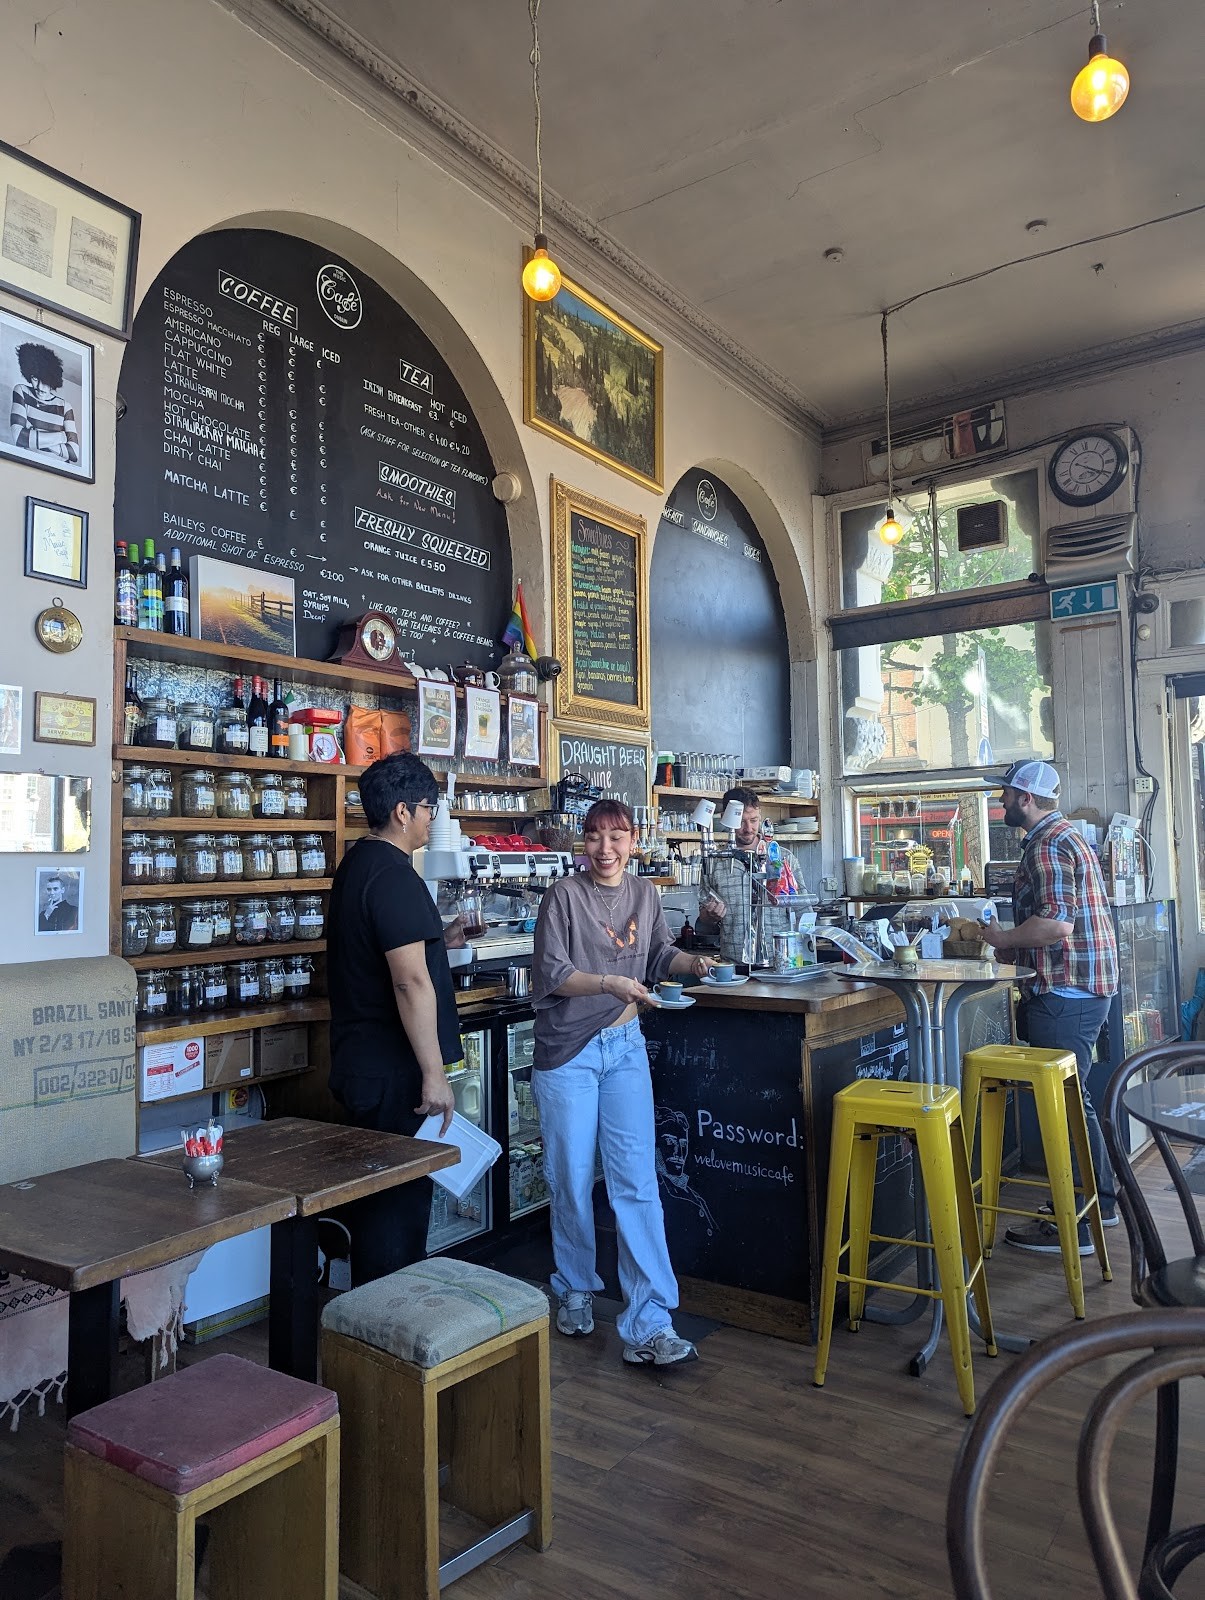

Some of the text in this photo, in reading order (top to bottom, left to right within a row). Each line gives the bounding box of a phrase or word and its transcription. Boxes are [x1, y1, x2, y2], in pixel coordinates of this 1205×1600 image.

[164, 288, 212, 318] ESPRESSO
[221, 277, 295, 324] COFFEE
[164, 302, 204, 326] ESPRESSO
[208, 320, 252, 346] MACCHIATO
[164, 316, 221, 348] AMERICANO
[165, 330, 232, 366] CAPPUCCINO
[262, 320, 341, 364] REG LARGE ICED
[164, 344, 190, 362] FLAT
[196, 358, 226, 379] WHITE
[164, 357, 198, 380] LATTE
[402, 364, 430, 390] TEA
[164, 371, 218, 402] STRAWBERRY
[220, 394, 245, 412] MOCHA
[164, 387, 204, 410] MOCHA
[363, 379, 383, 396] IRISH
[388, 390, 422, 413] BREAKFAST
[164, 403, 186, 417] HOT
[190, 411, 250, 440] CHOCOLATE
[430, 399, 467, 424] HOT ICED
[164, 412, 224, 444] STRAWBERRY
[226, 434, 258, 457] MATCHA
[164, 428, 192, 446] CHAI
[198, 440, 230, 460] LATTE
[364, 404, 386, 420] FRESH
[429, 434, 448, 447] €4.00
[449, 442, 470, 456] €4.20
[164, 442, 193, 461] DIRTY
[198, 455, 222, 471] CHAI
[360, 425, 488, 486] (ASK STAFF FOR SELECTION OF TEA FLAVOURS)
[164, 469, 208, 494] MATCHA
[214, 486, 250, 506] LATTE
[376, 488, 394, 502] Ask
[400, 495, 410, 506] for
[414, 500, 426, 513] New
[380, 466, 453, 506] SMOOTHIES
[164, 512, 206, 532] BAILEYS
[211, 526, 246, 544] COFFEE
[357, 511, 487, 567] FRESHLY SQUEEZED
[693, 521, 728, 547] SANDWICHES
[744, 545, 760, 561] SIDES
[164, 528, 305, 572] ADDITIONAL SHOT OF ESPRESSO
[364, 541, 391, 556] ORANGE
[395, 550, 418, 565] JUICE
[303, 590, 318, 600] OAT,
[332, 596, 350, 609] MILK,
[361, 568, 472, 605] ASK FOR OTHER BAILEYS DRINKS
[303, 600, 330, 612] SYRUPS
[303, 610, 326, 623] Decaf
[369, 602, 461, 629] LIKE OUR TEAS AND COFFEE?
[396, 617, 410, 628] OUR
[452, 631, 475, 643] COFFEE
[476, 636, 494, 648] BEANS
[561, 740, 646, 771] DRAUGHT BEER
[32, 1004, 94, 1025] BRAZIL
[13, 1036, 35, 1057] NY
[40, 1033, 73, 1054] 2/3
[78, 1028, 120, 1049] 17/18
[697, 1109, 804, 1150] Password:
[694, 1148, 794, 1186] welovemusiccafe
